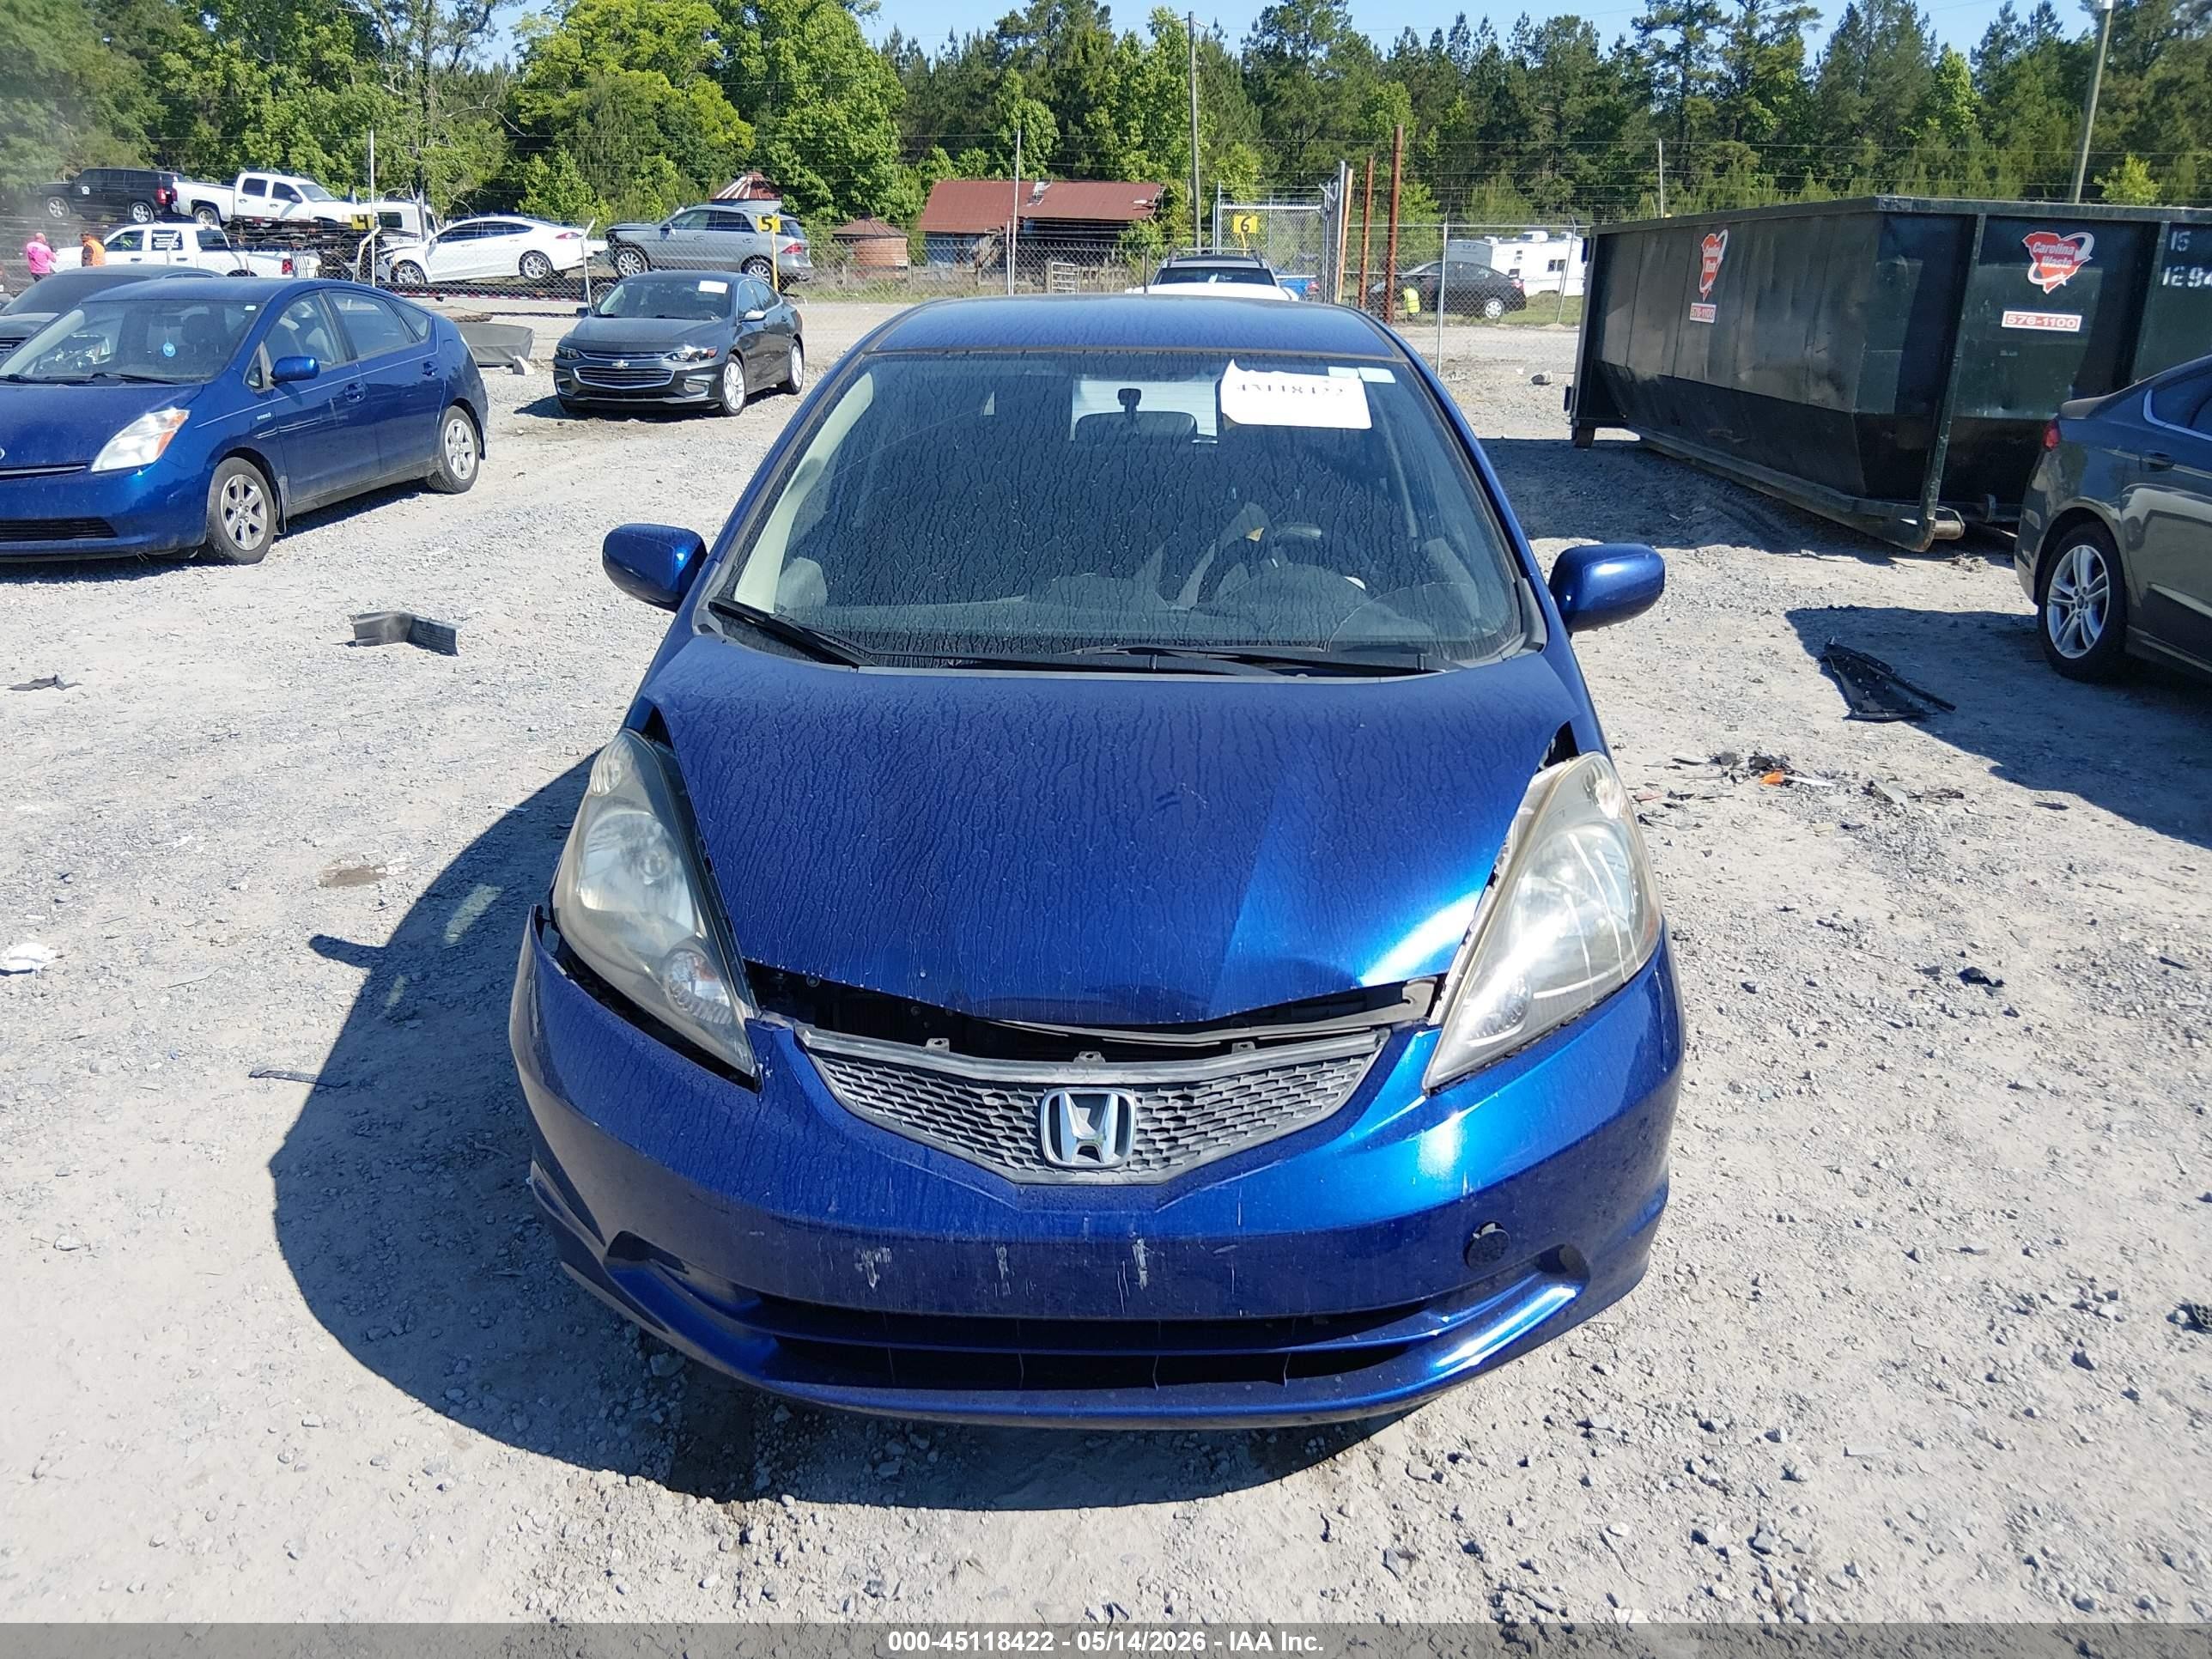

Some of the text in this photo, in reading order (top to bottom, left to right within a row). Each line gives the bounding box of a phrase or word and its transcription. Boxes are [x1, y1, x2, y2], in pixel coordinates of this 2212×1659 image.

[356, 215, 369, 229] 4
[761, 216, 773, 233] 5
[1240, 215, 1252, 233] 6
[2032, 241, 2075, 256] Carolina
[2040, 255, 2073, 269] Waste
[2006, 314, 2077, 329] 576-1100
